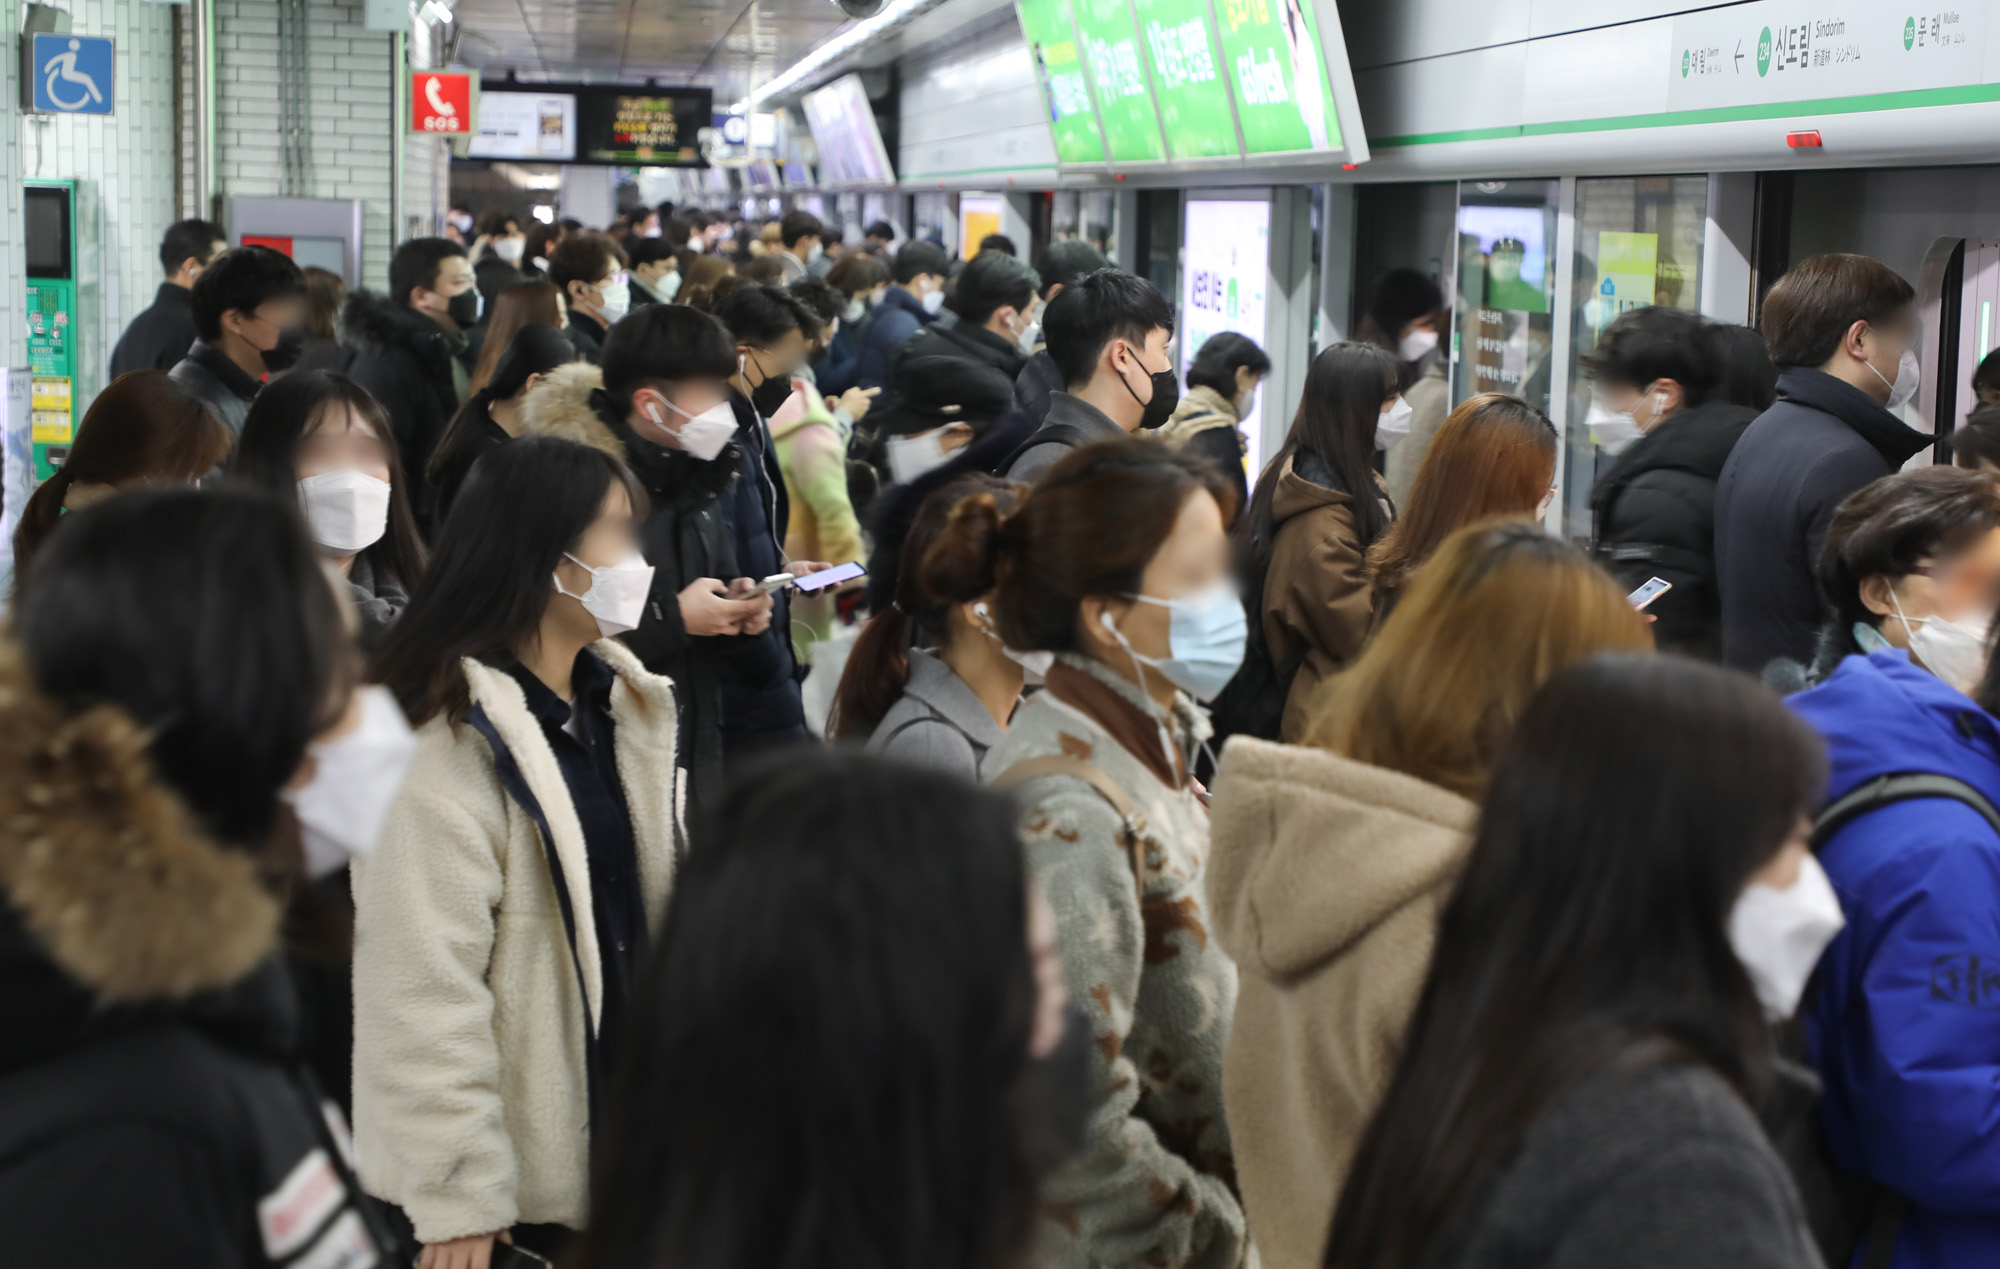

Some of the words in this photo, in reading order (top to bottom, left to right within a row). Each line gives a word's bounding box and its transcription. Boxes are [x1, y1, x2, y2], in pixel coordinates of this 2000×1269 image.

[1815, 17, 1845, 39] Sindorim
[1759, 41, 1770, 61] 234
[1775, 21, 1811, 71] 신도림
[1813, 47, 1831, 67] 新道林
[423, 115, 459, 132] SOS
